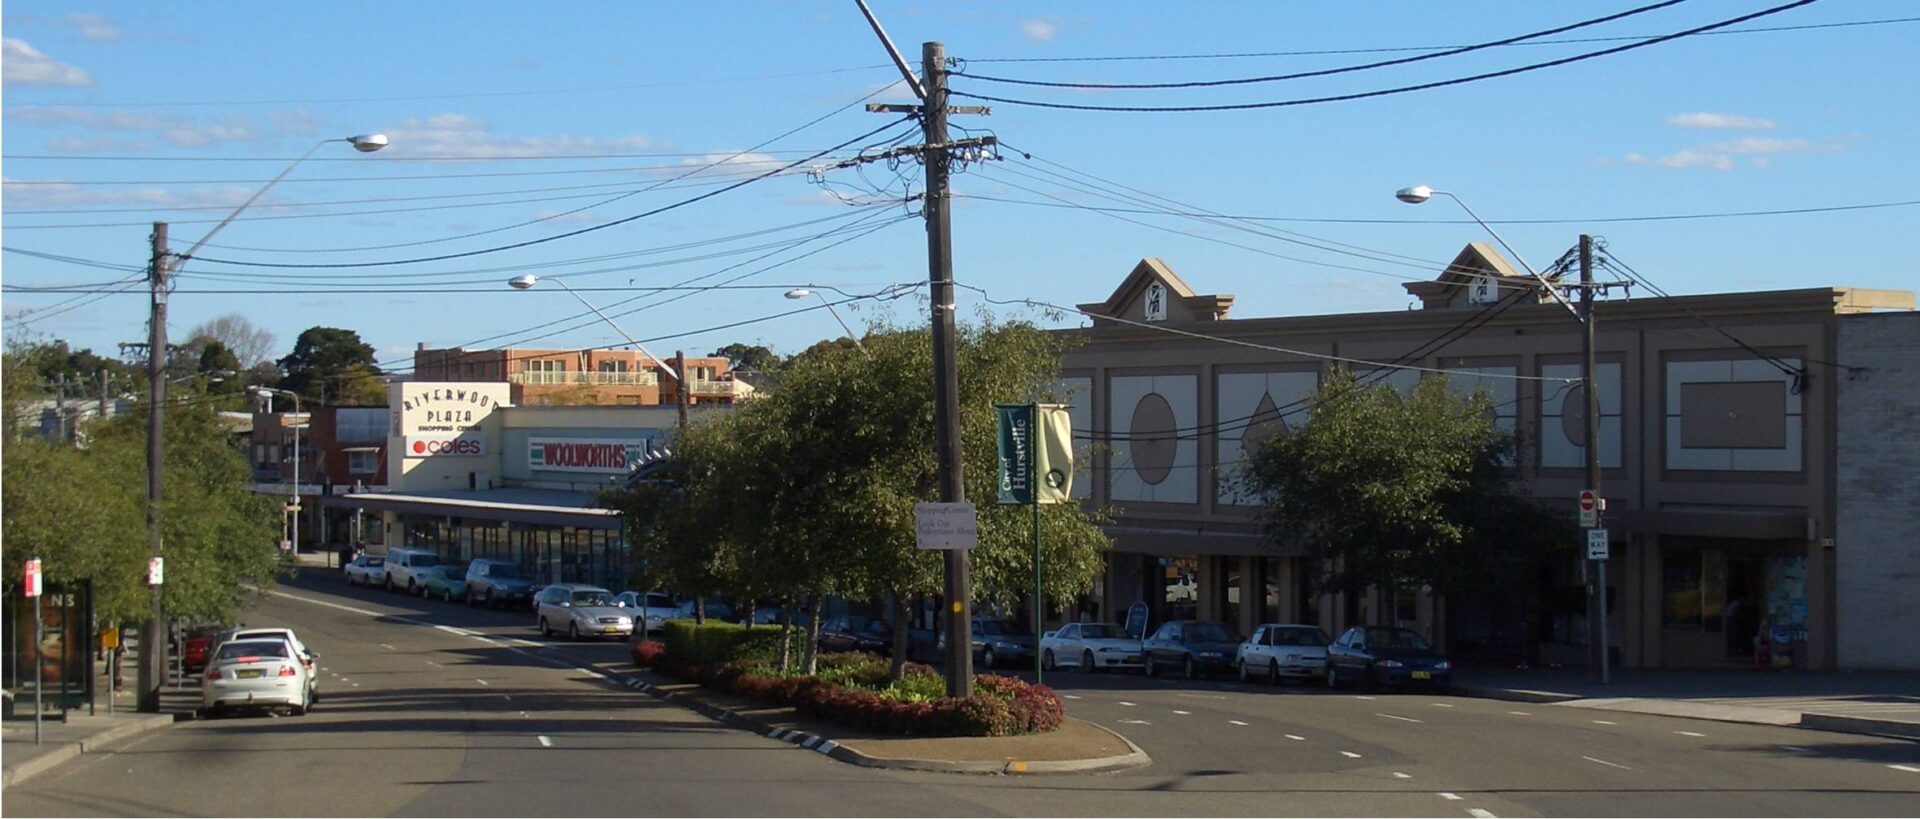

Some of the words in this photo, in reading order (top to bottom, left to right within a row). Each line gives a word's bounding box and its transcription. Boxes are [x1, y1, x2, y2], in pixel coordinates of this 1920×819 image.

[404, 389, 499, 411] RIVERWOOD
[427, 410, 472, 422] PLAZA
[427, 439, 480, 454] coles
[543, 443, 625, 468] WOOLWORTHS
[1012, 419, 1025, 489] Hurstville
[1001, 456, 1011, 468] of
[1002, 469, 1012, 491] City
